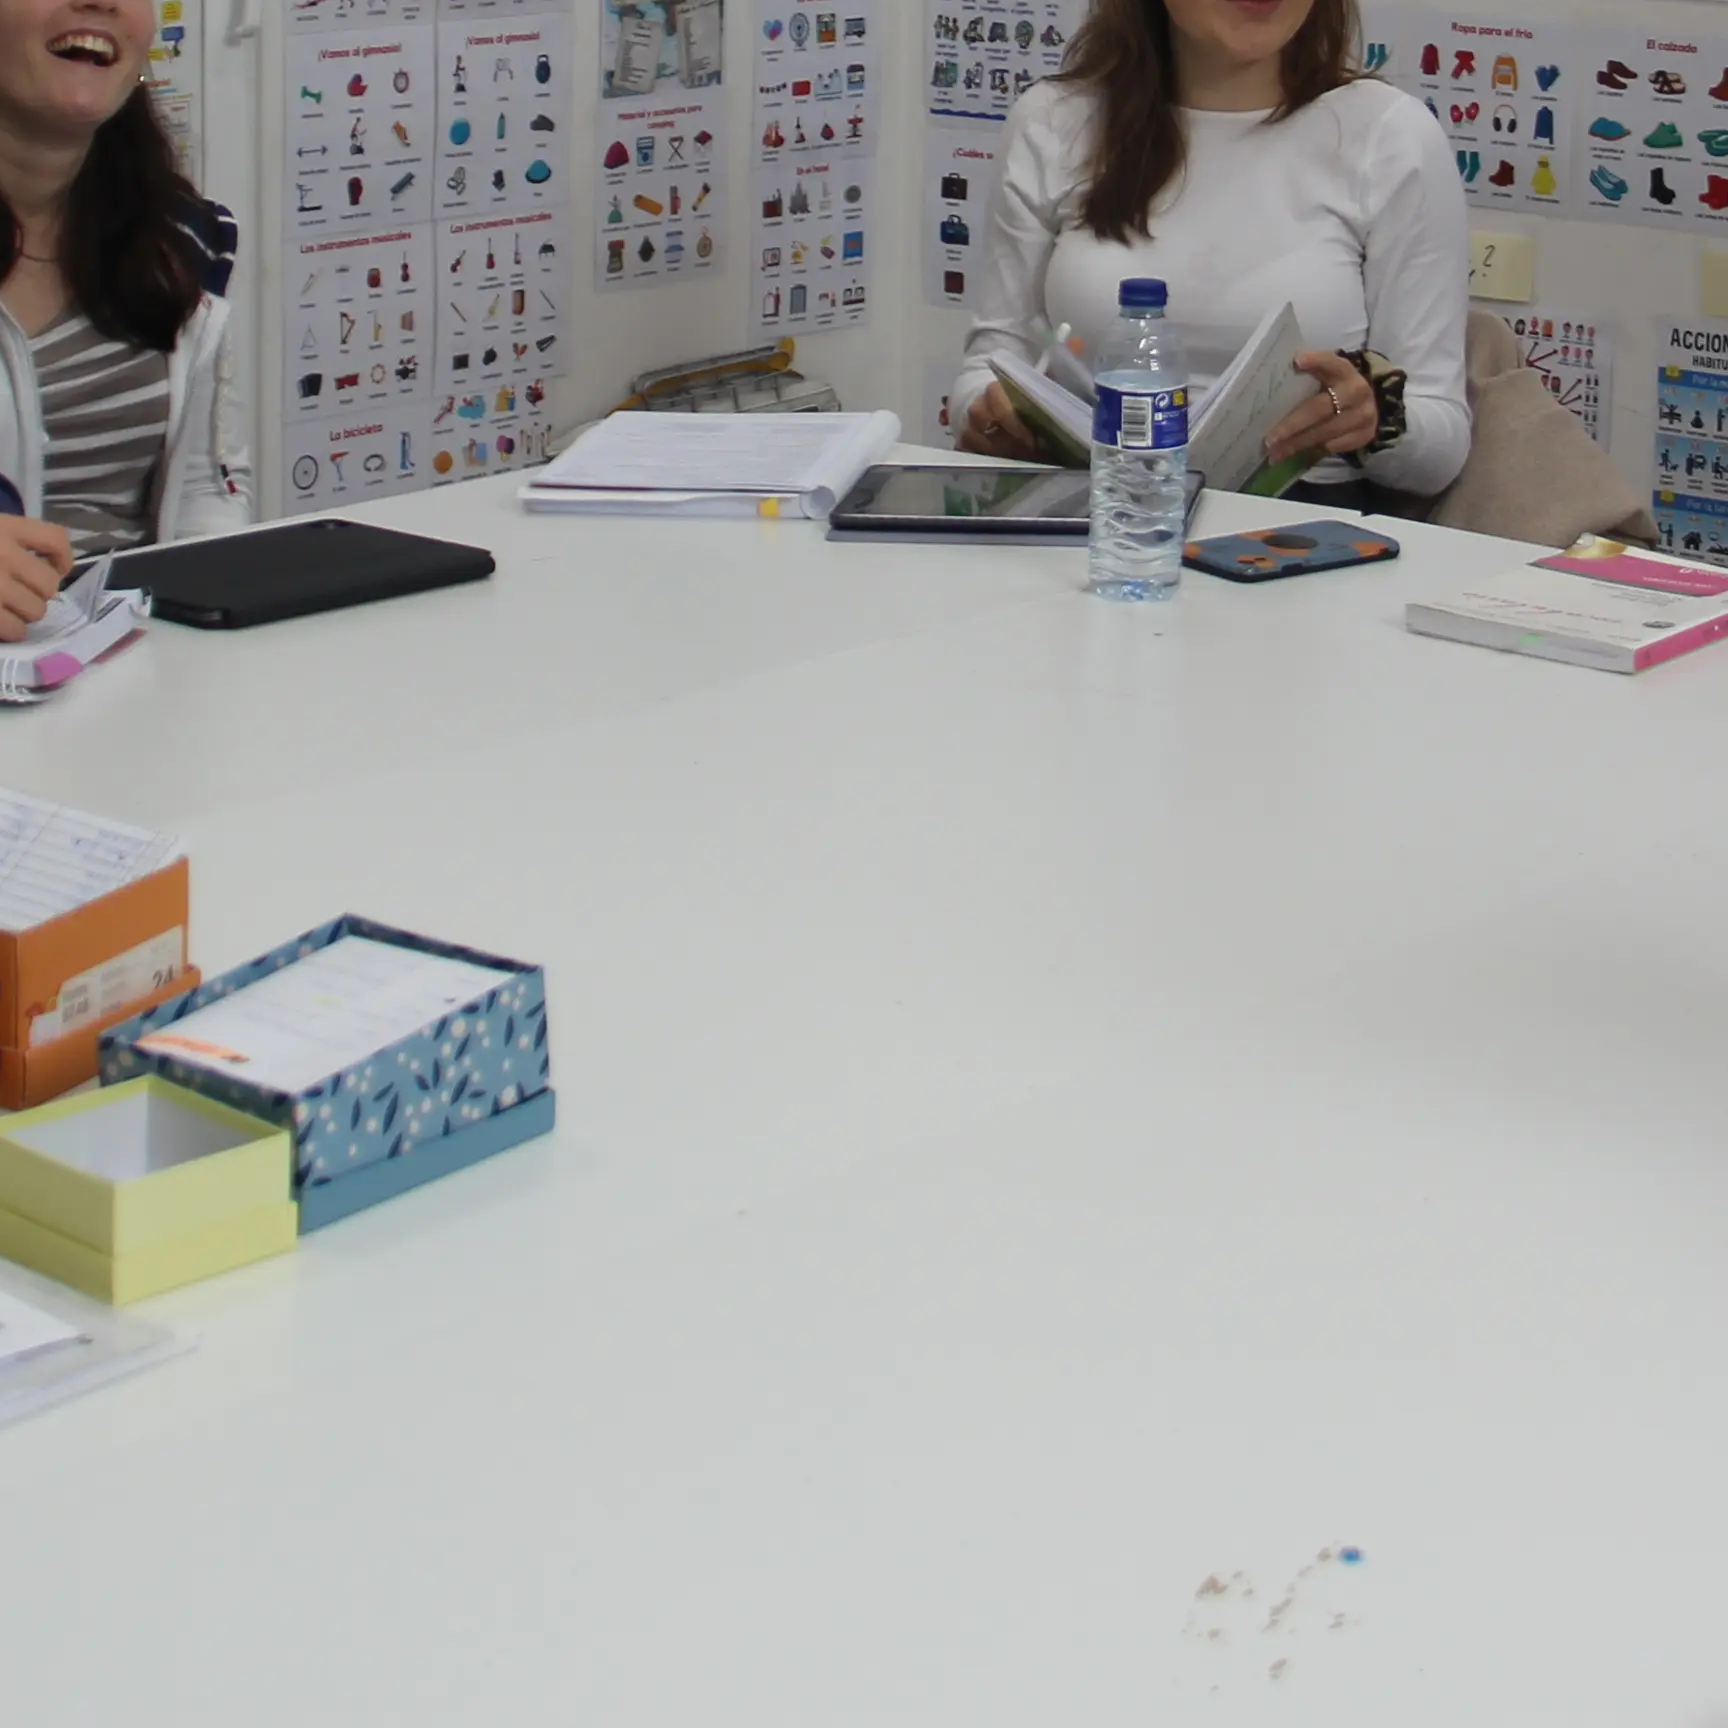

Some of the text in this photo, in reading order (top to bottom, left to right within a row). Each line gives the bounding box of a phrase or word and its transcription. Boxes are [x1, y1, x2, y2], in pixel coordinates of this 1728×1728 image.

[1452, 22, 1476, 36] Ropa
[1476, 26, 1502, 38] para
[1504, 28, 1516, 38] el
[1646, 38, 1698, 54] El calzado
[330, 424, 384, 442] La bicicleta
